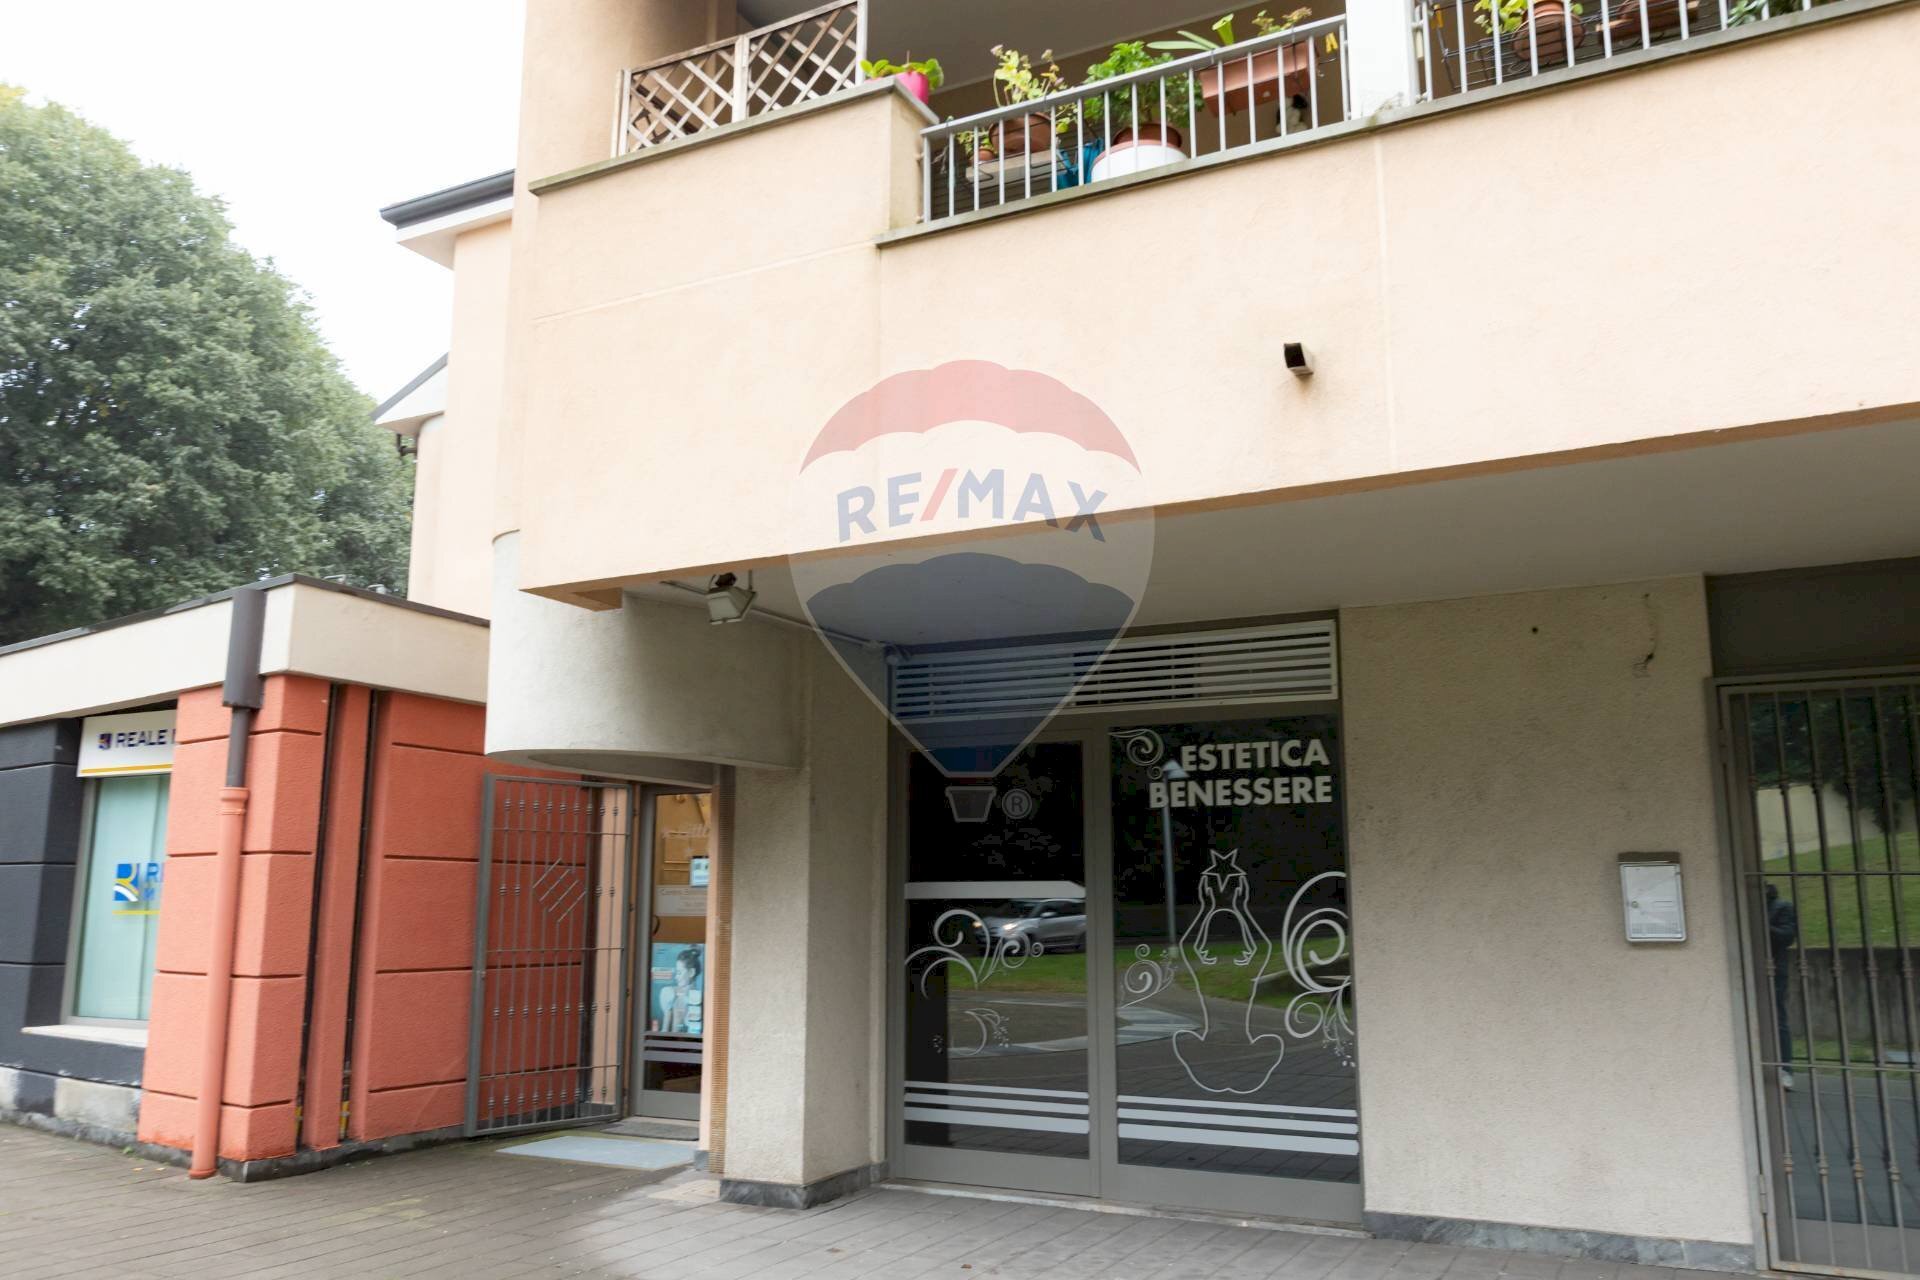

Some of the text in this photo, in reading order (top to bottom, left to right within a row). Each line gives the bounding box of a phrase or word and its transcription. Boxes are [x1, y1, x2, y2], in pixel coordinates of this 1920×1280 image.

[115, 729, 168, 748] REALE
[1181, 739, 1330, 772] ESTETICA
[1150, 776, 1332, 808] BENESSERE
